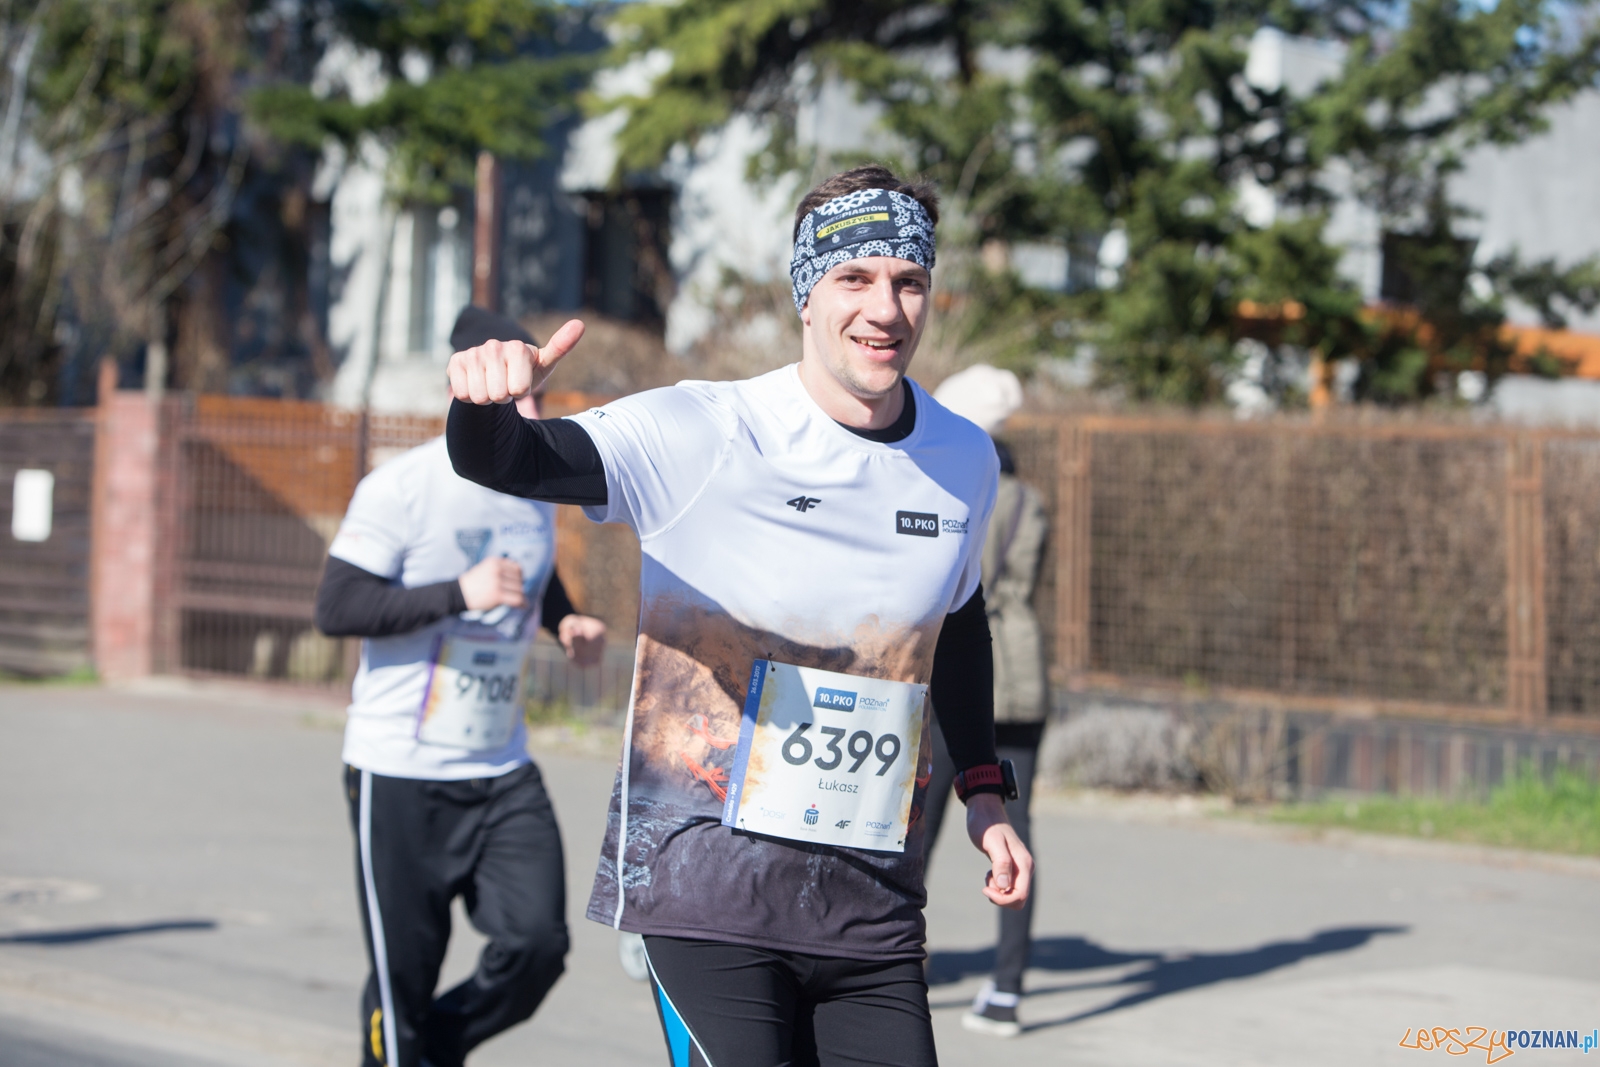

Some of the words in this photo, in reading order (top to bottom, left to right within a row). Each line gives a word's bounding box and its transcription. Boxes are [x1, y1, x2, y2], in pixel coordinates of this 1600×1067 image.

[825, 215, 875, 234] JAKUSZYCE
[786, 495, 822, 513] 4F
[914, 518, 936, 531] PKO
[455, 673, 518, 703] 9108
[750, 665, 761, 695] 26.03.2017
[832, 695, 853, 707] PKO
[781, 722, 901, 777] 6399
[818, 778, 859, 794] Łukasz
[835, 820, 851, 829] 4F
